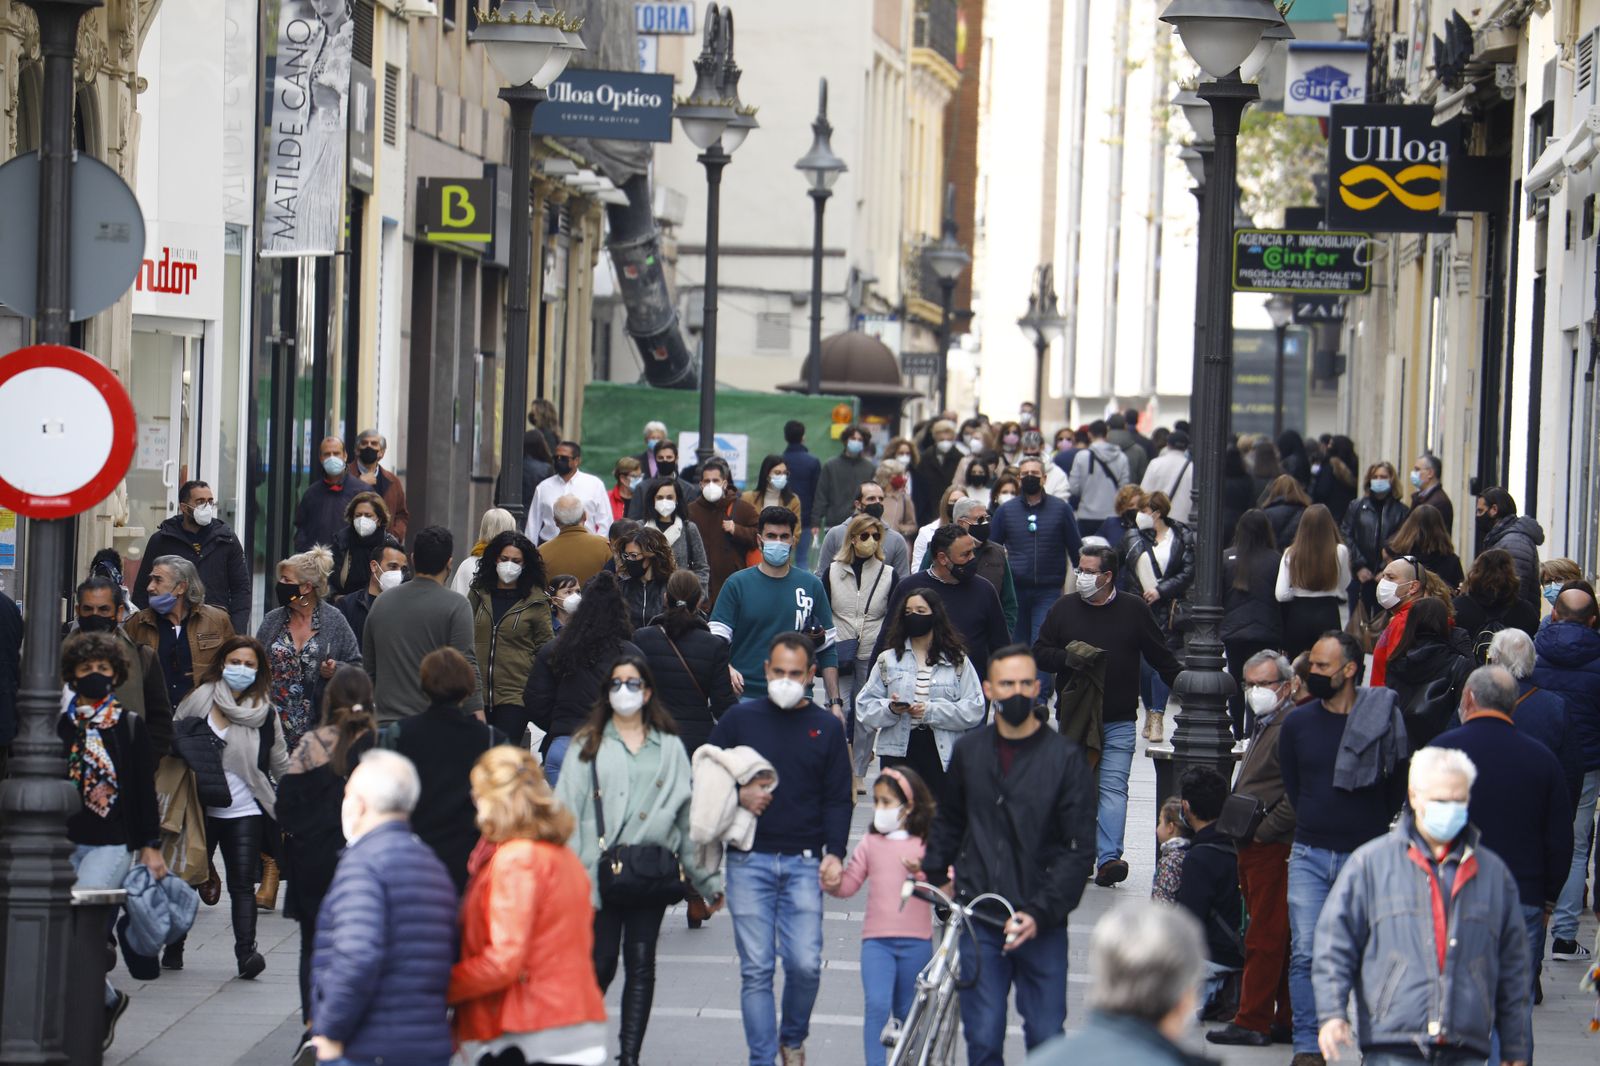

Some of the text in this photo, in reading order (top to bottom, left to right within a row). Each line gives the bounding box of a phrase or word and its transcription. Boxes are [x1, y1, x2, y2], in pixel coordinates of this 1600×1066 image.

[546, 81, 661, 112] Ulloa Optico
[273, 19, 311, 240] MATILDE CANO
[561, 112, 595, 122] CENTRO
[1341, 126, 1448, 162] Ulloa
[441, 185, 476, 228] B
[1238, 233, 1282, 246] AGENCIA
[1263, 245, 1339, 270] Cinfer
